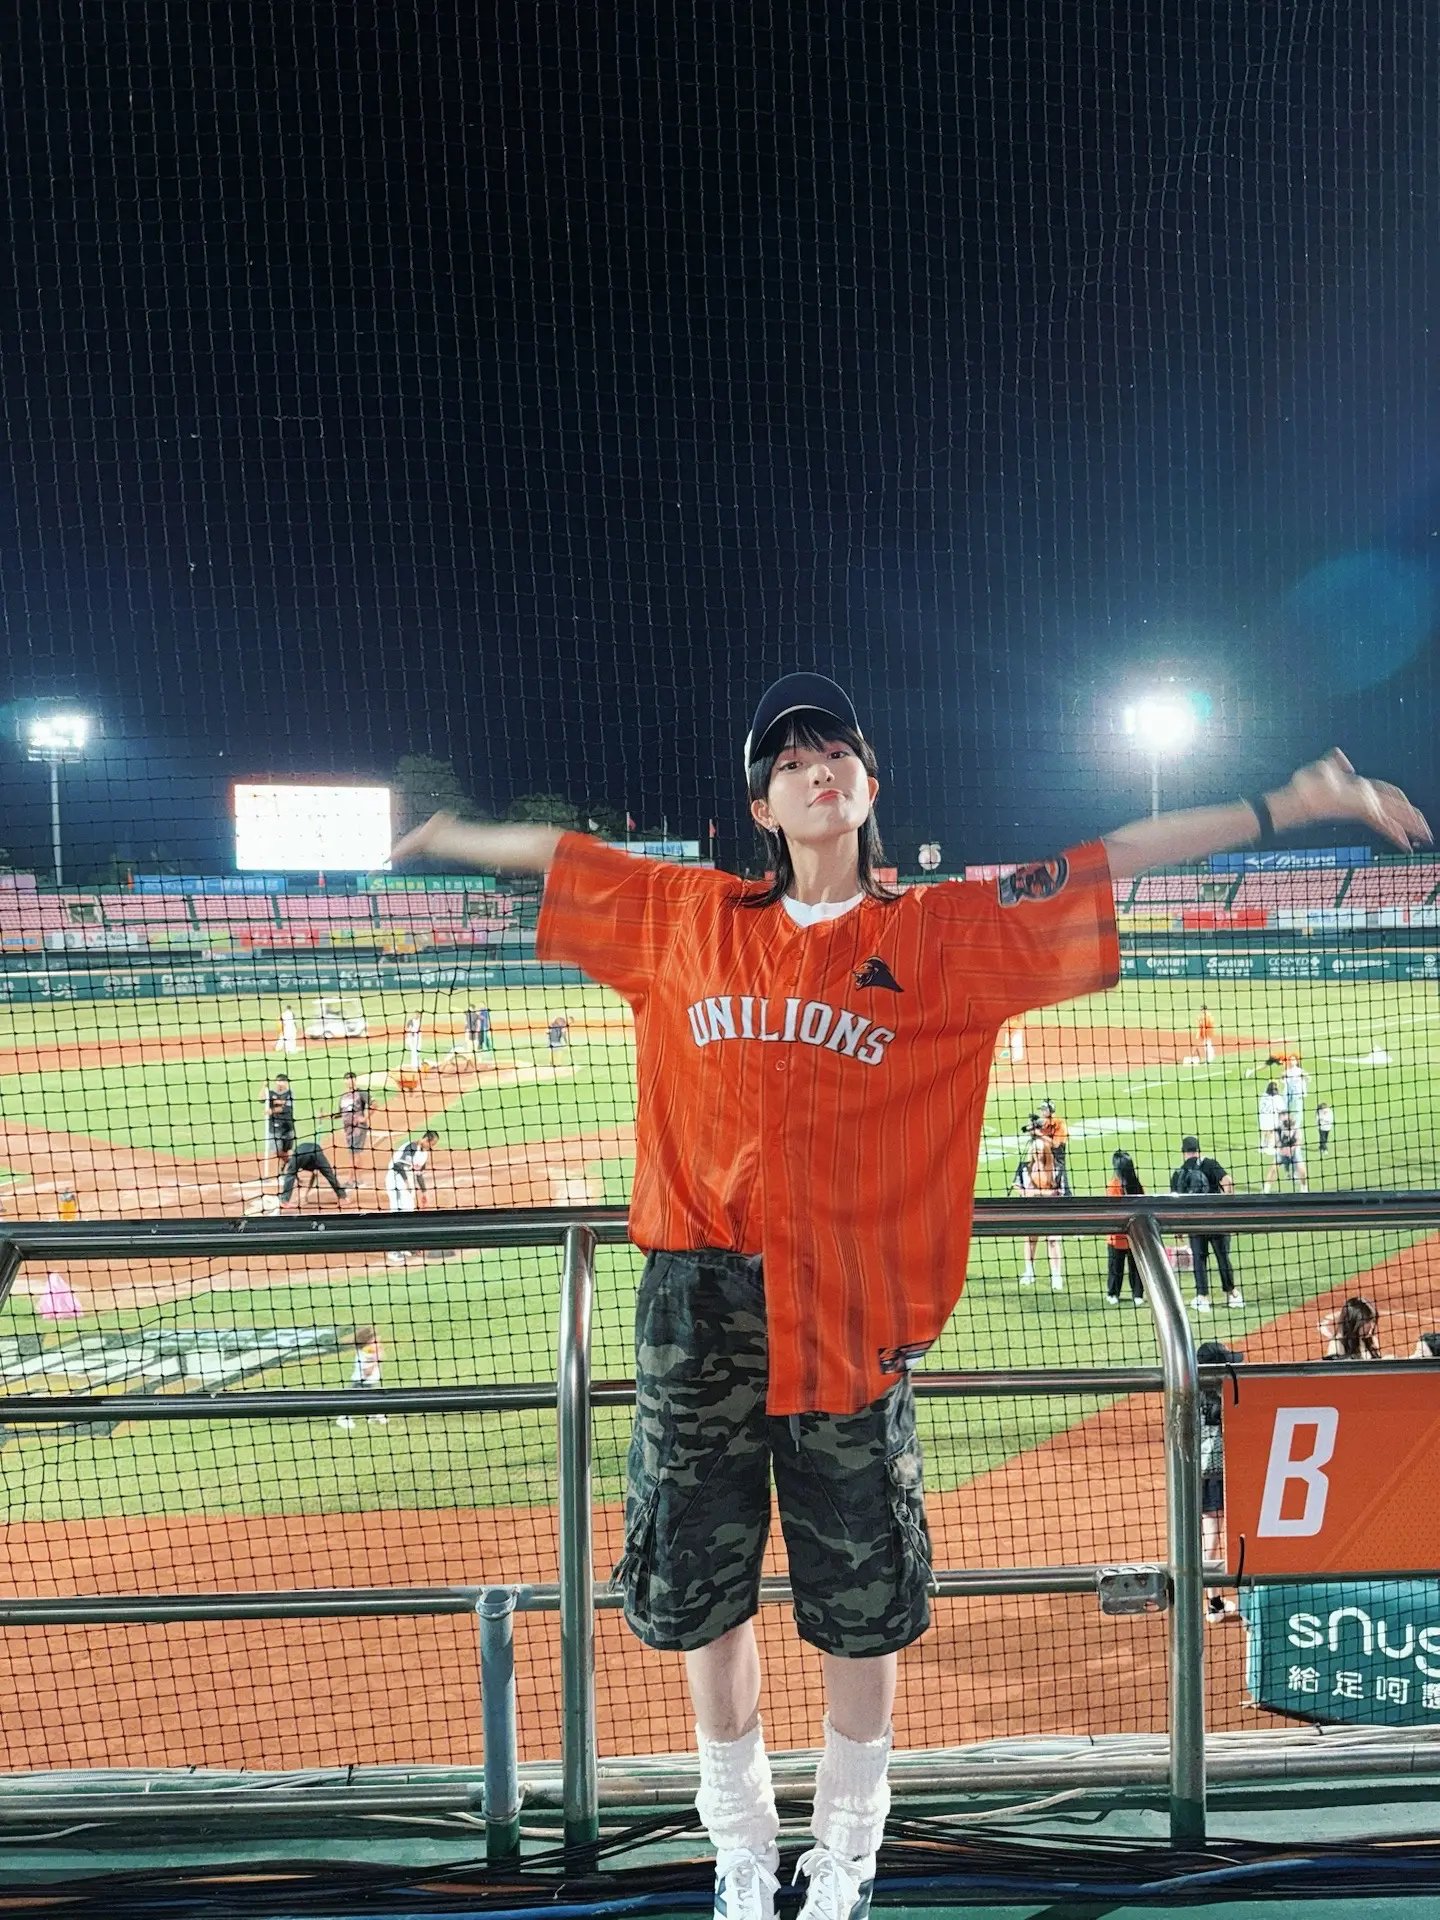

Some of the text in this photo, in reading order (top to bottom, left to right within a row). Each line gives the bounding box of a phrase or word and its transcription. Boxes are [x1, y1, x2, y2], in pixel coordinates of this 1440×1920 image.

[1268, 957, 1310, 966] COSMED
[687, 996, 897, 1066] UNILIONS
[1256, 1406, 1339, 1538] B
